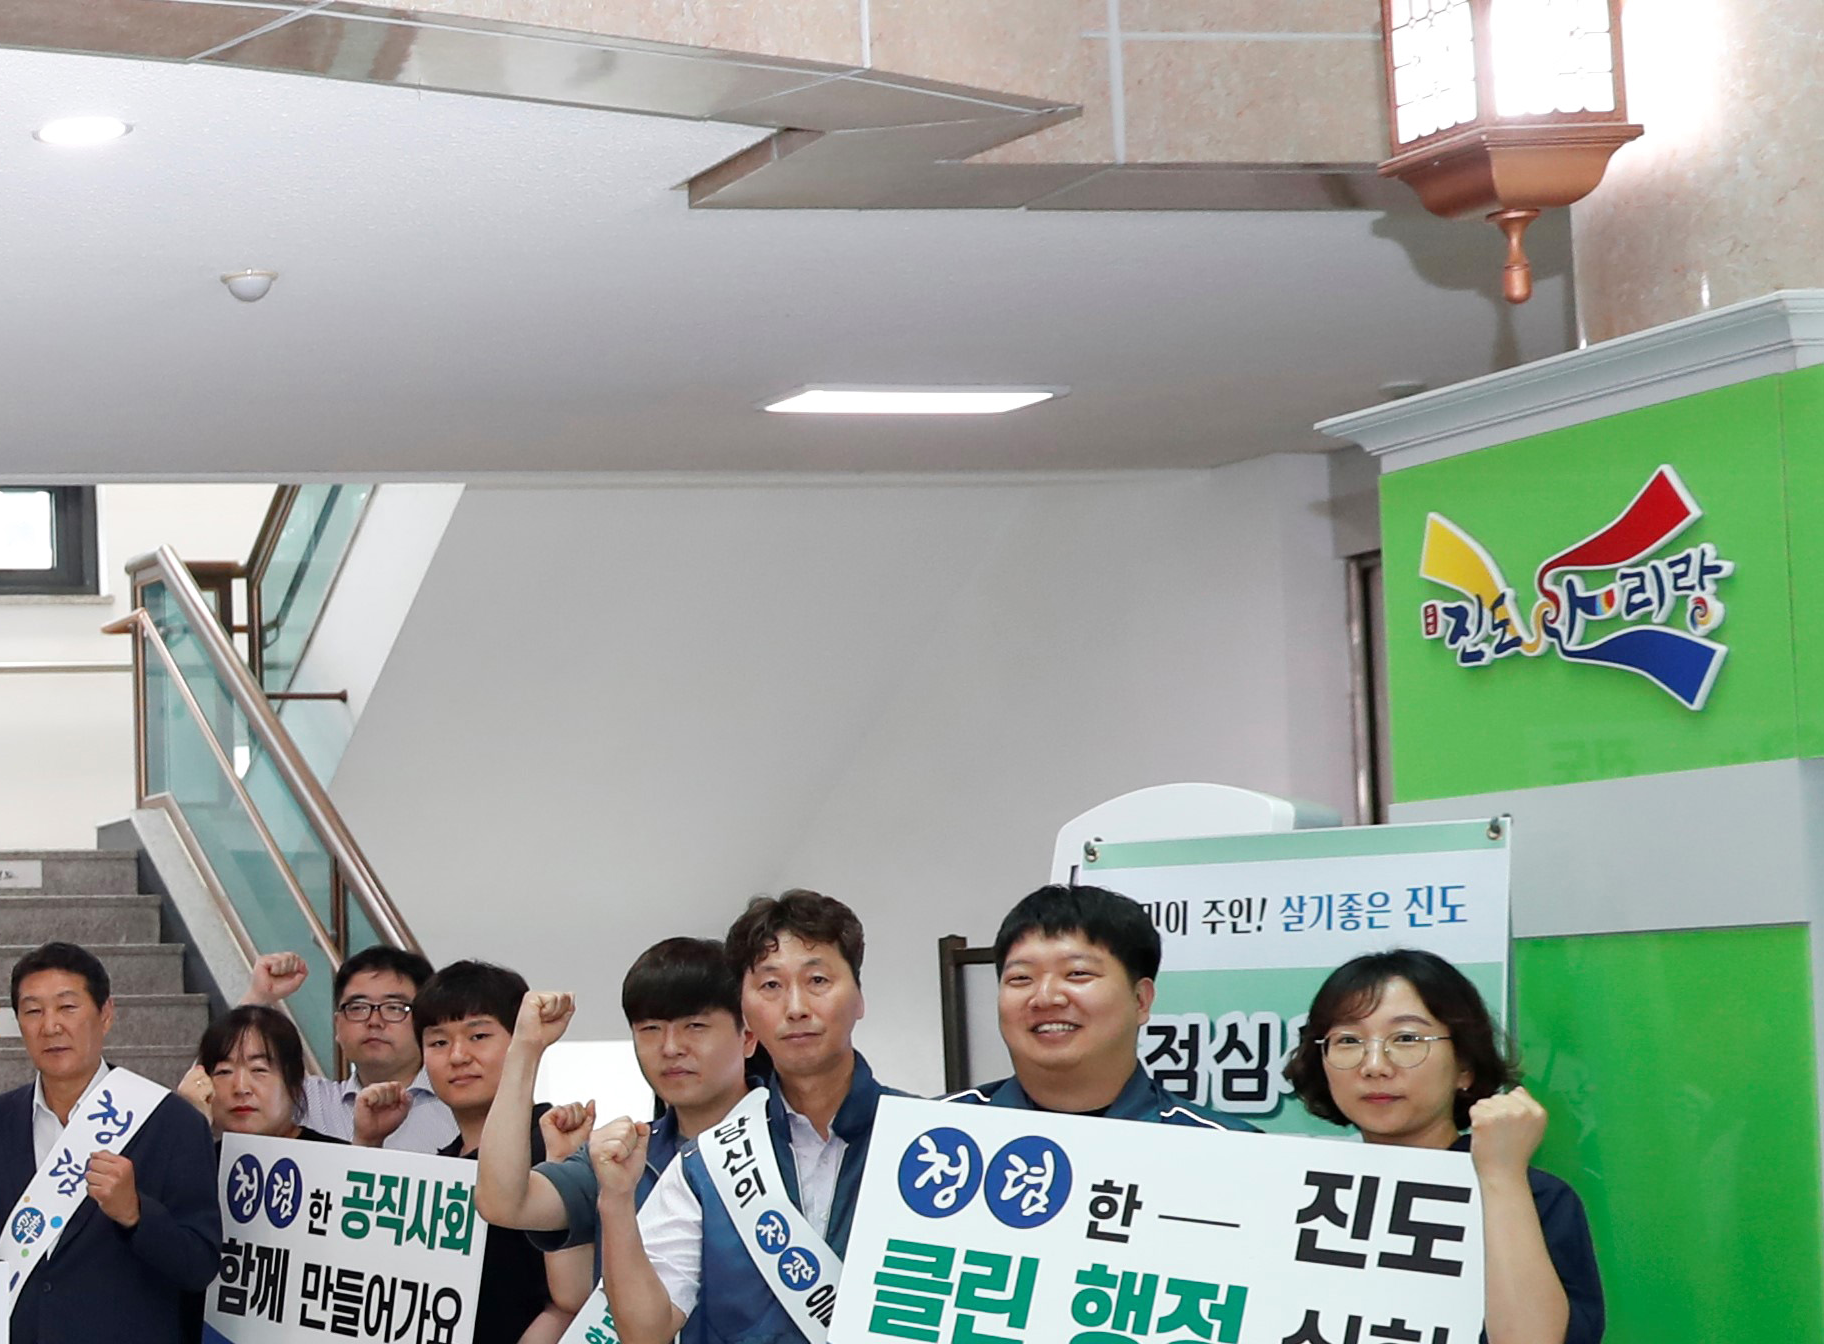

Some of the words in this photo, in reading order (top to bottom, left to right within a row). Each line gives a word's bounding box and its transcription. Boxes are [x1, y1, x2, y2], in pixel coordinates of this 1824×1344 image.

[1201, 897, 1268, 935] 주인!
[1279, 891, 1391, 932] 살기좋은
[1404, 885, 1469, 928] 진도
[227, 1153, 332, 1236] 청렴한
[340, 1170, 475, 1256] 공직사회
[714, 1116, 768, 1208] 당신의
[897, 1126, 1143, 1244] 청렴한
[1295, 1169, 1473, 1278] 진도
[217, 1237, 290, 1323] 함께
